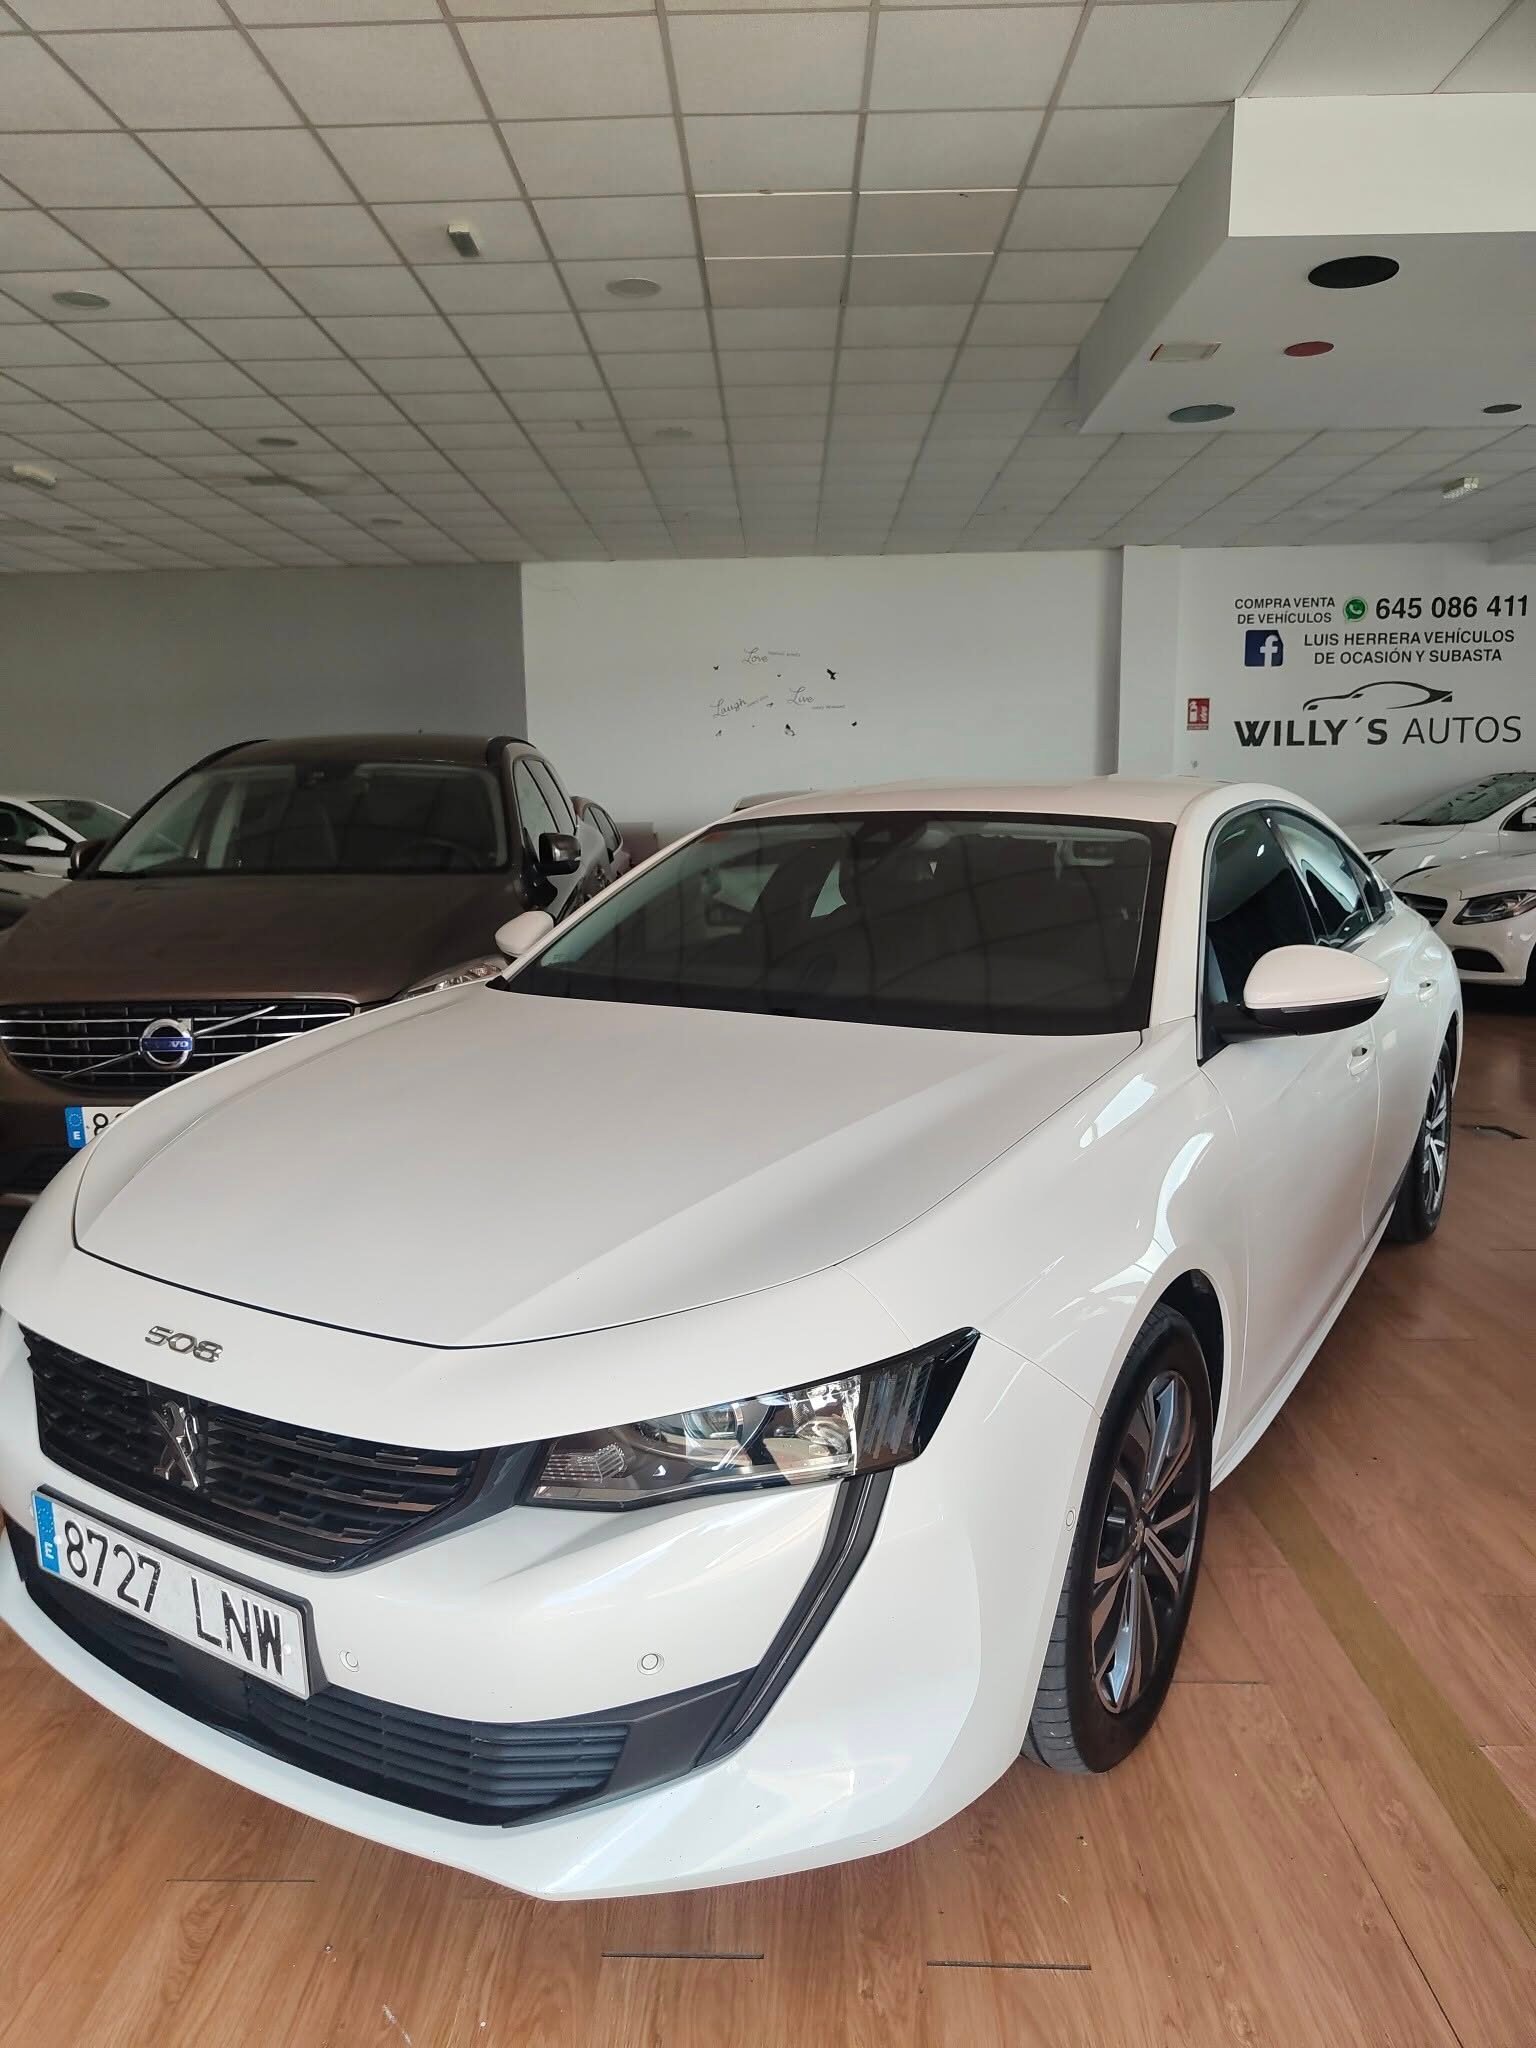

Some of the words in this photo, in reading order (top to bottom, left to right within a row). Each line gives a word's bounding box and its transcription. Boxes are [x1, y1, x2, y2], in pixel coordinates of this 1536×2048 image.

[1235, 598, 1293, 610] COMPRA
[1294, 597, 1336, 609] VENTA
[1375, 597, 1423, 620] 645
[1431, 596, 1478, 619] 086
[1486, 595, 1528, 617] 411
[1237, 614, 1255, 625] DE
[1258, 611, 1332, 624] VEHÍCULOS
[1304, 633, 1339, 647] LUIS
[1344, 631, 1421, 646] HERRERA
[1424, 628, 1515, 645] VEHÍCULOS
[743, 647, 769, 665] Love
[1314, 652, 1335, 665] DE
[1340, 647, 1412, 665] OCASIÓN
[1416, 651, 1426, 663] Y
[1428, 649, 1502, 663] SUBASTA
[1402, 716, 1522, 745] AUTOS
[145, 1325, 224, 1363] 508
[44, 1542, 54, 1560] E
[64, 1519, 162, 1614] 8727
[190, 1576, 285, 1677] LNW
